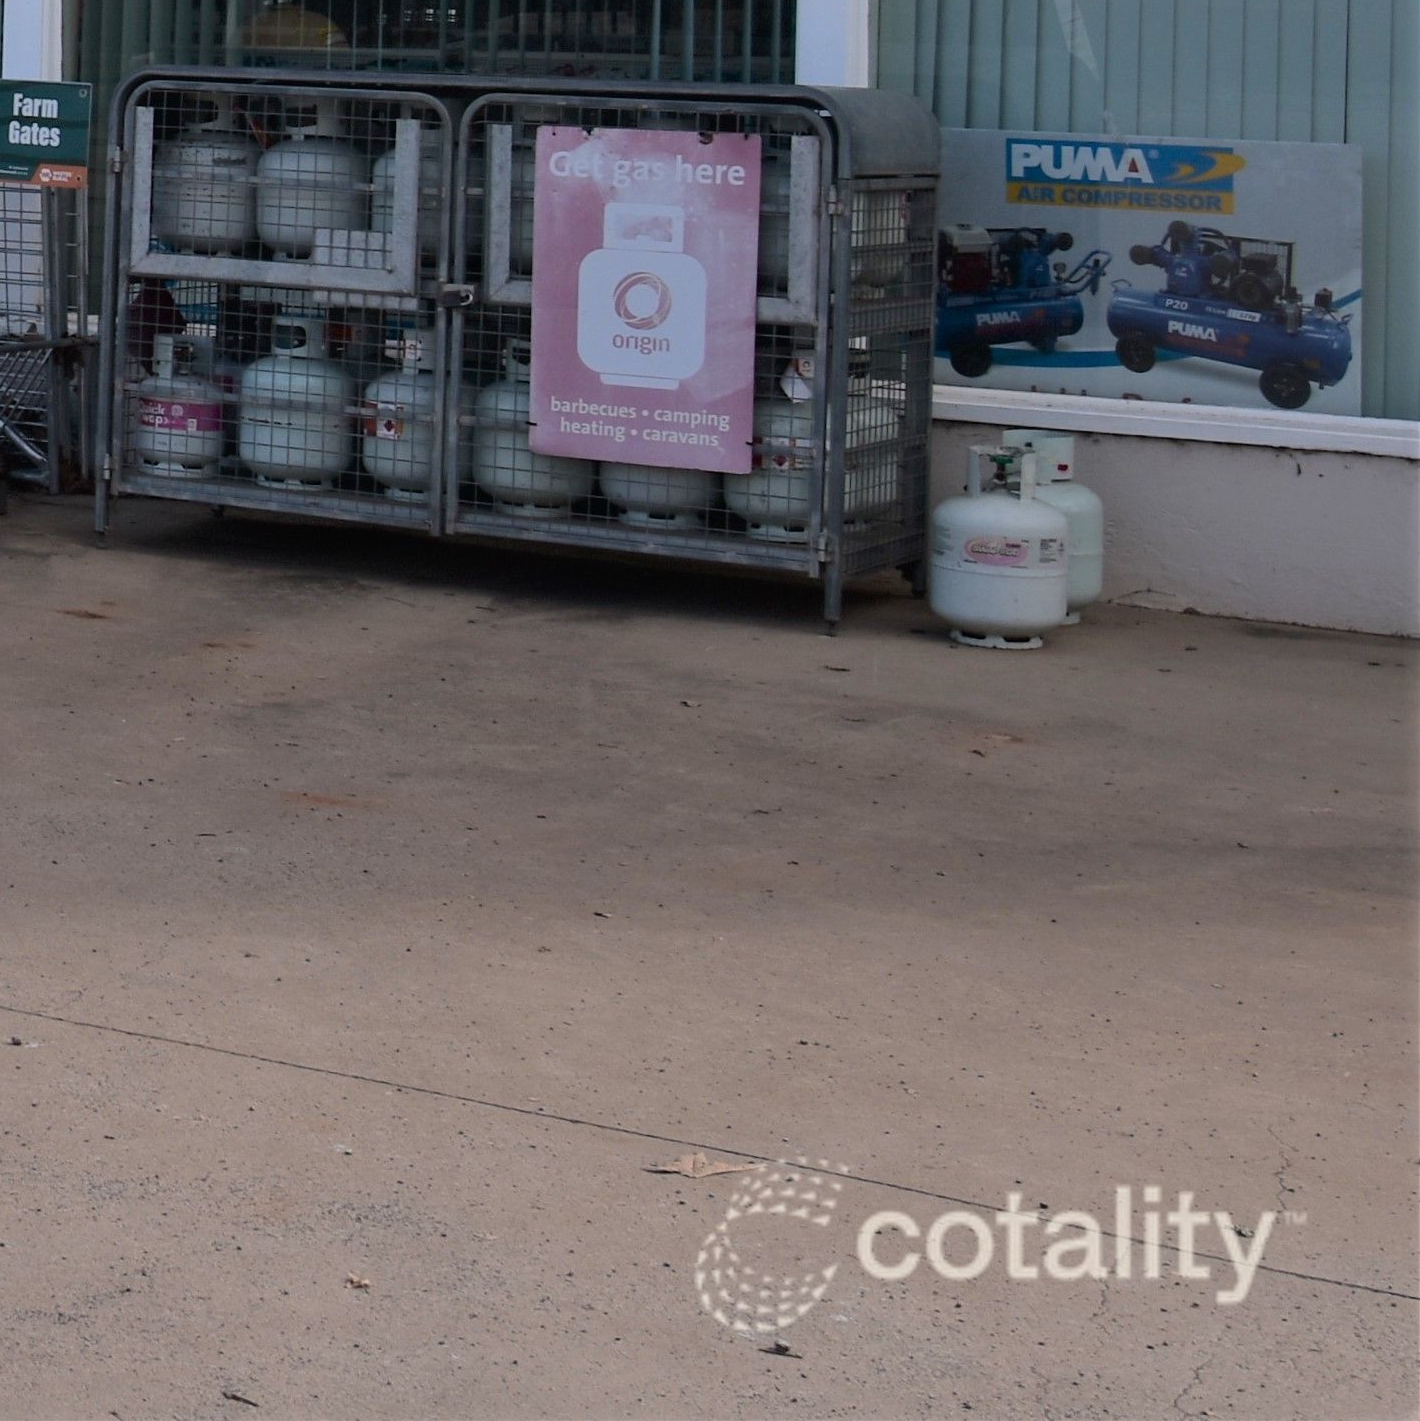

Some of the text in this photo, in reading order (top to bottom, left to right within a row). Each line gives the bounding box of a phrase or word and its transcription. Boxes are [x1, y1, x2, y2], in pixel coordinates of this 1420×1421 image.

[13, 92, 59, 119] Farm
[8, 120, 61, 147] Gates
[548, 150, 746, 189] Get gas here
[1010, 142, 1155, 184] PUMA
[1016, 186, 1222, 212] AIR COMPRESSOR
[976, 310, 1021, 326] PUMA
[1167, 320, 1217, 343] PUMA
[611, 333, 671, 356] origin
[550, 395, 731, 433] barbecues camping
[560, 417, 720, 447] heating caravans
